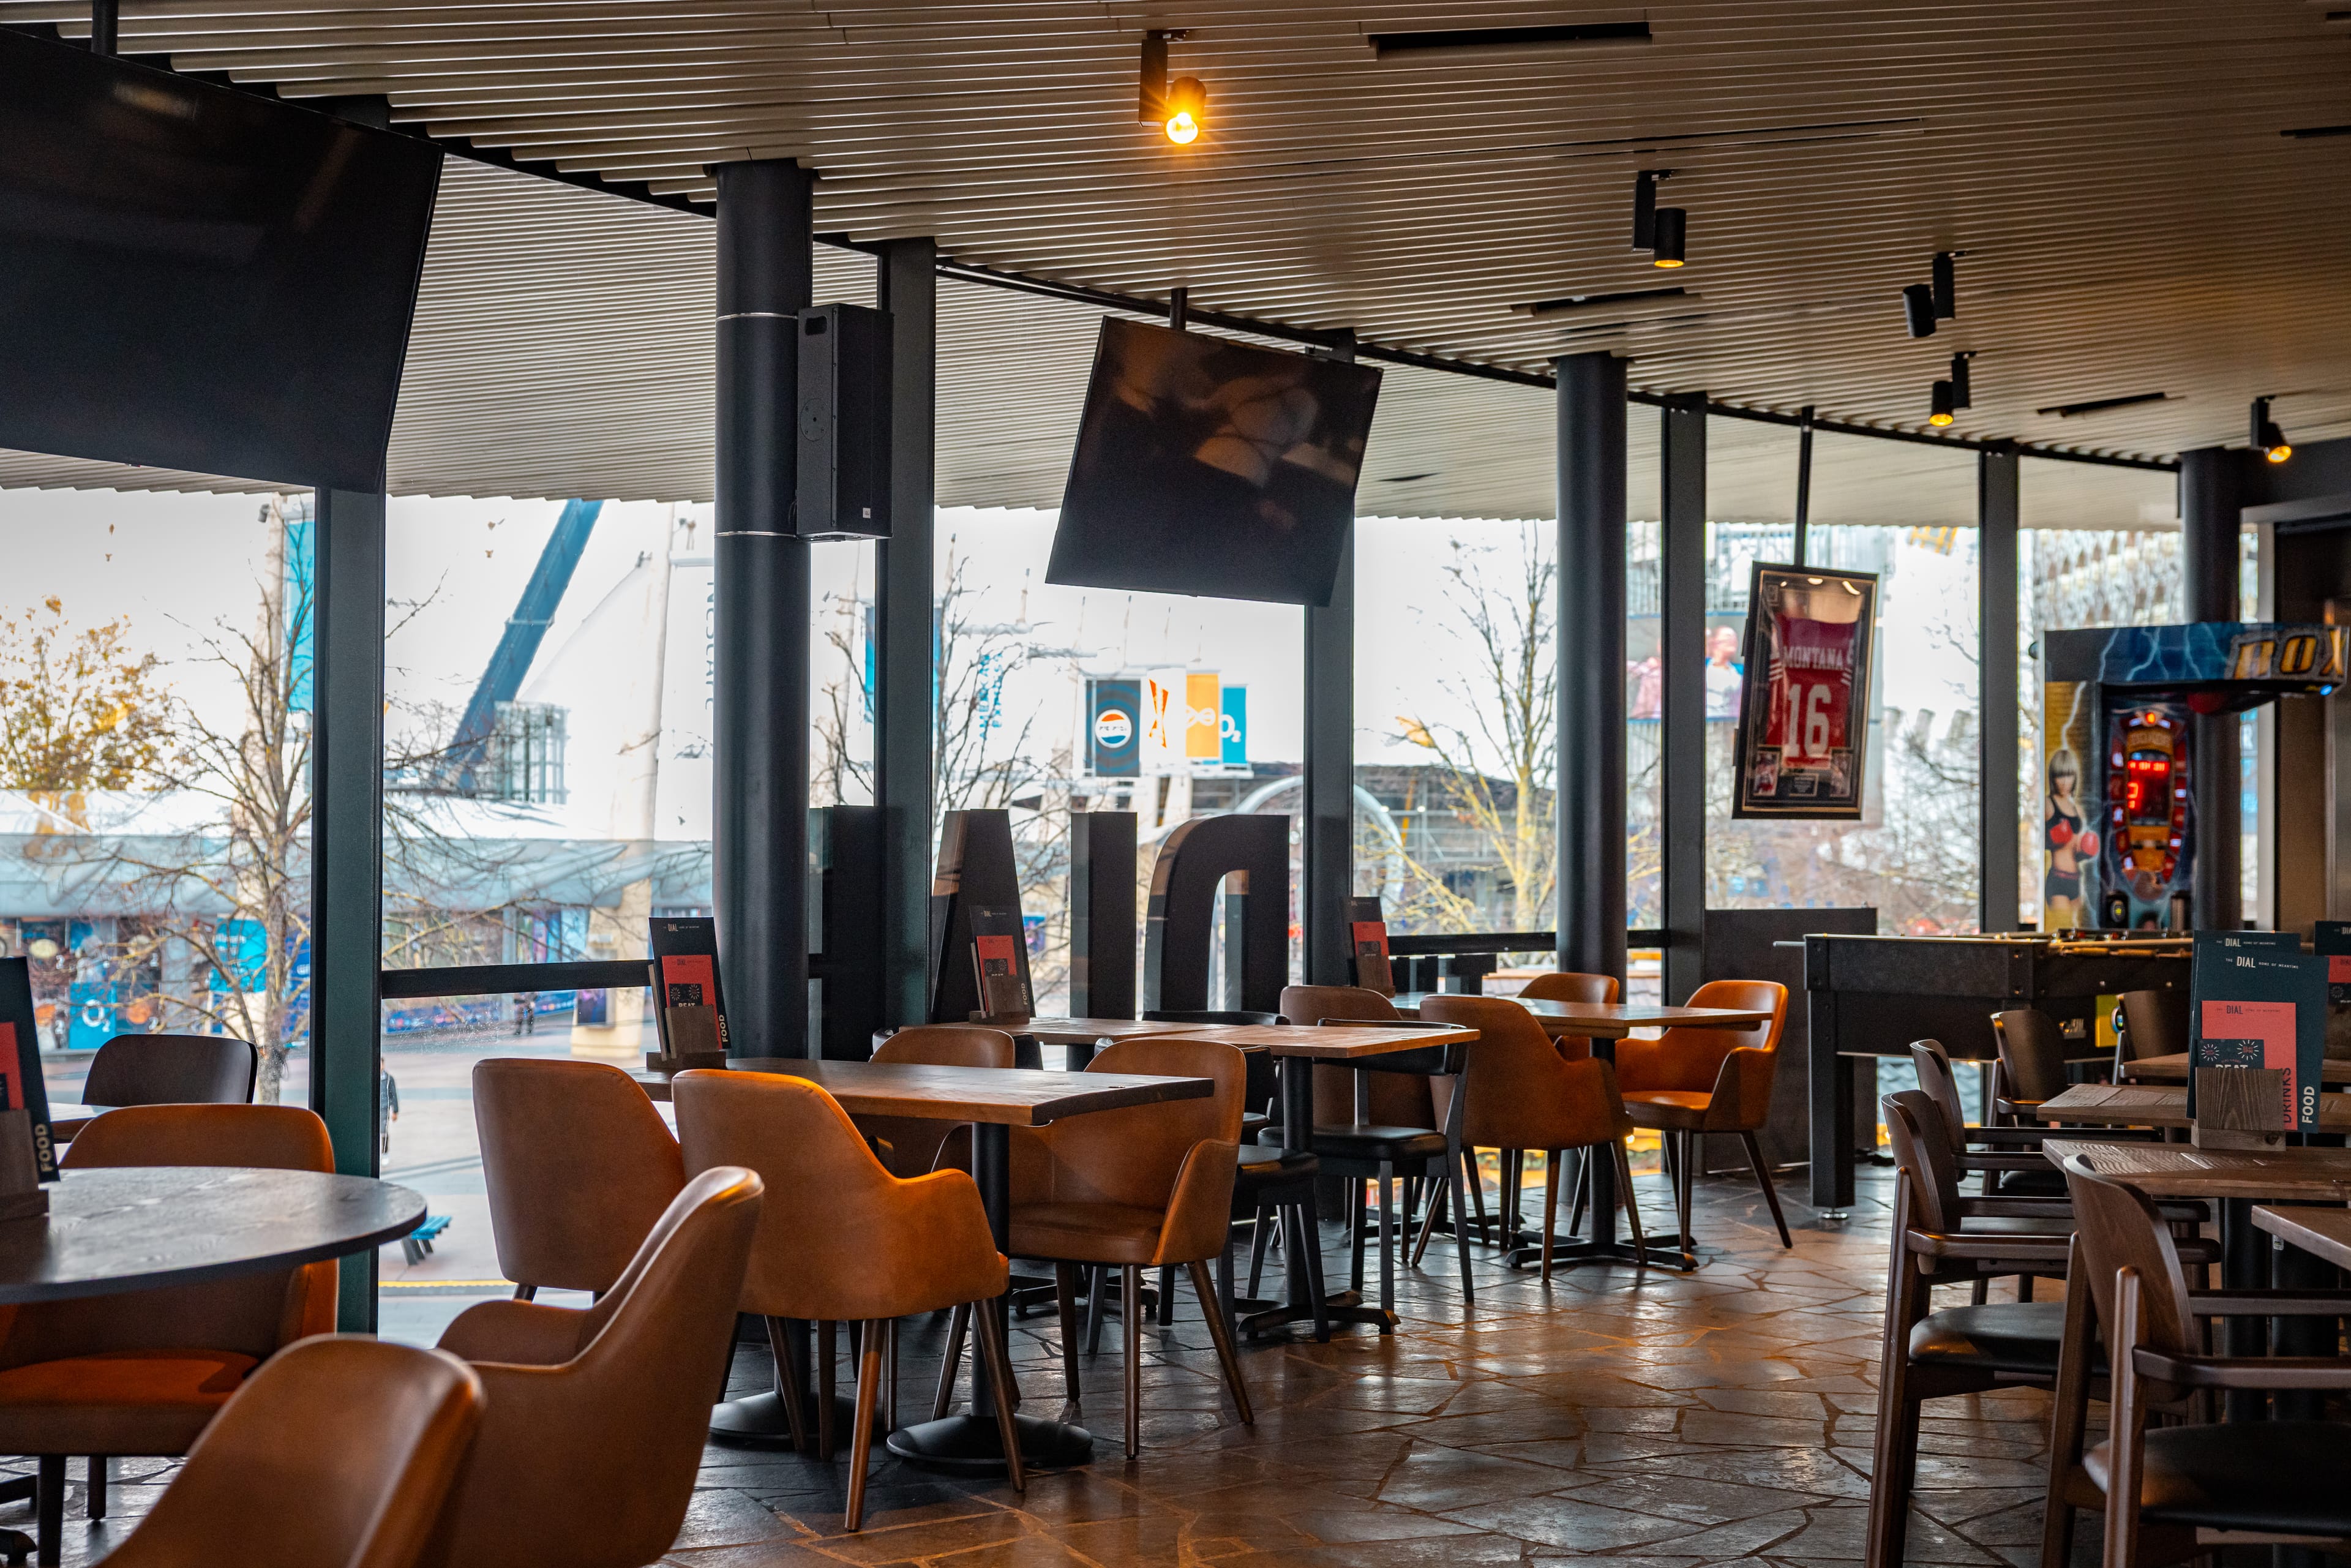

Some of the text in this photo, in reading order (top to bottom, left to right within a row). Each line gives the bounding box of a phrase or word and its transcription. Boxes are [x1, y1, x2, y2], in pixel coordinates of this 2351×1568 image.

[1783, 645, 1843, 670] MONTANA
[1783, 683, 1831, 759] 16
[2225, 938, 2241, 947] DIAL
[2237, 956, 2256, 968] DIAL
[2226, 1005, 2243, 1014] DIAL
[719, 1015, 729, 1042] FOOD
[2282, 1067, 2292, 1123] DRINKS
[2301, 1086, 2315, 1123] FOOD
[34, 1123, 53, 1172] FOOD
